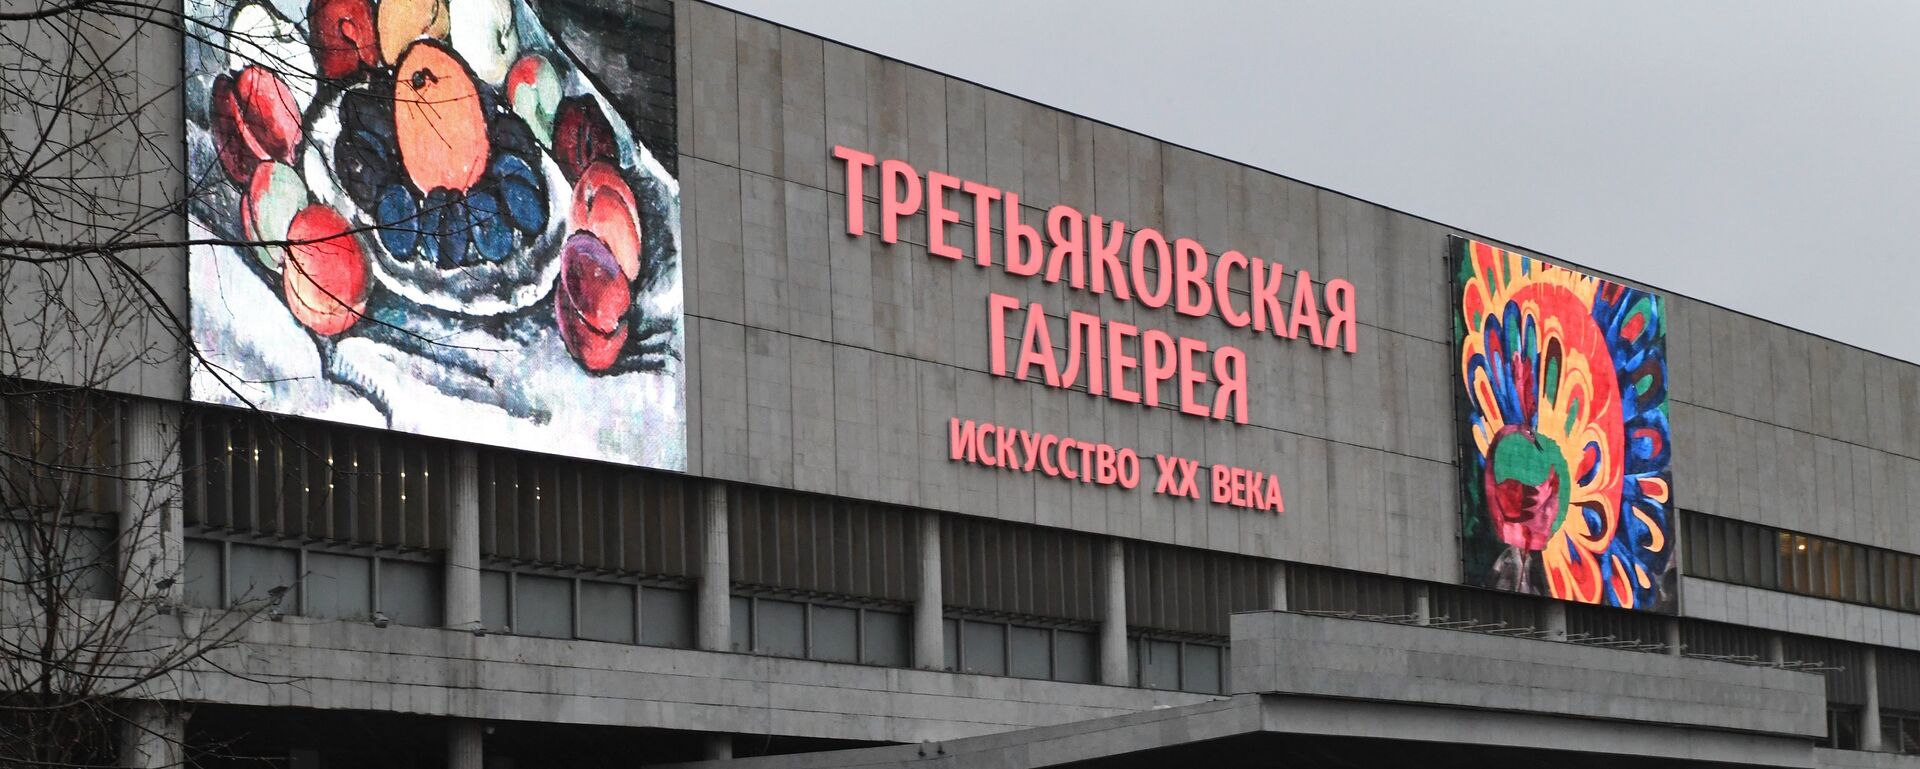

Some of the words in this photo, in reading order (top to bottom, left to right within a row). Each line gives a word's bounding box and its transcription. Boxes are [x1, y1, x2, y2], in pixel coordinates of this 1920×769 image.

[832, 144, 1358, 354] ТРЕТЬЯКОВСКАЯ
[988, 292, 1249, 425] ГАЛЕРЕЯ
[949, 416, 1140, 490] ИСКУССТВО
[1211, 463, 1285, 513] ВЕКА
